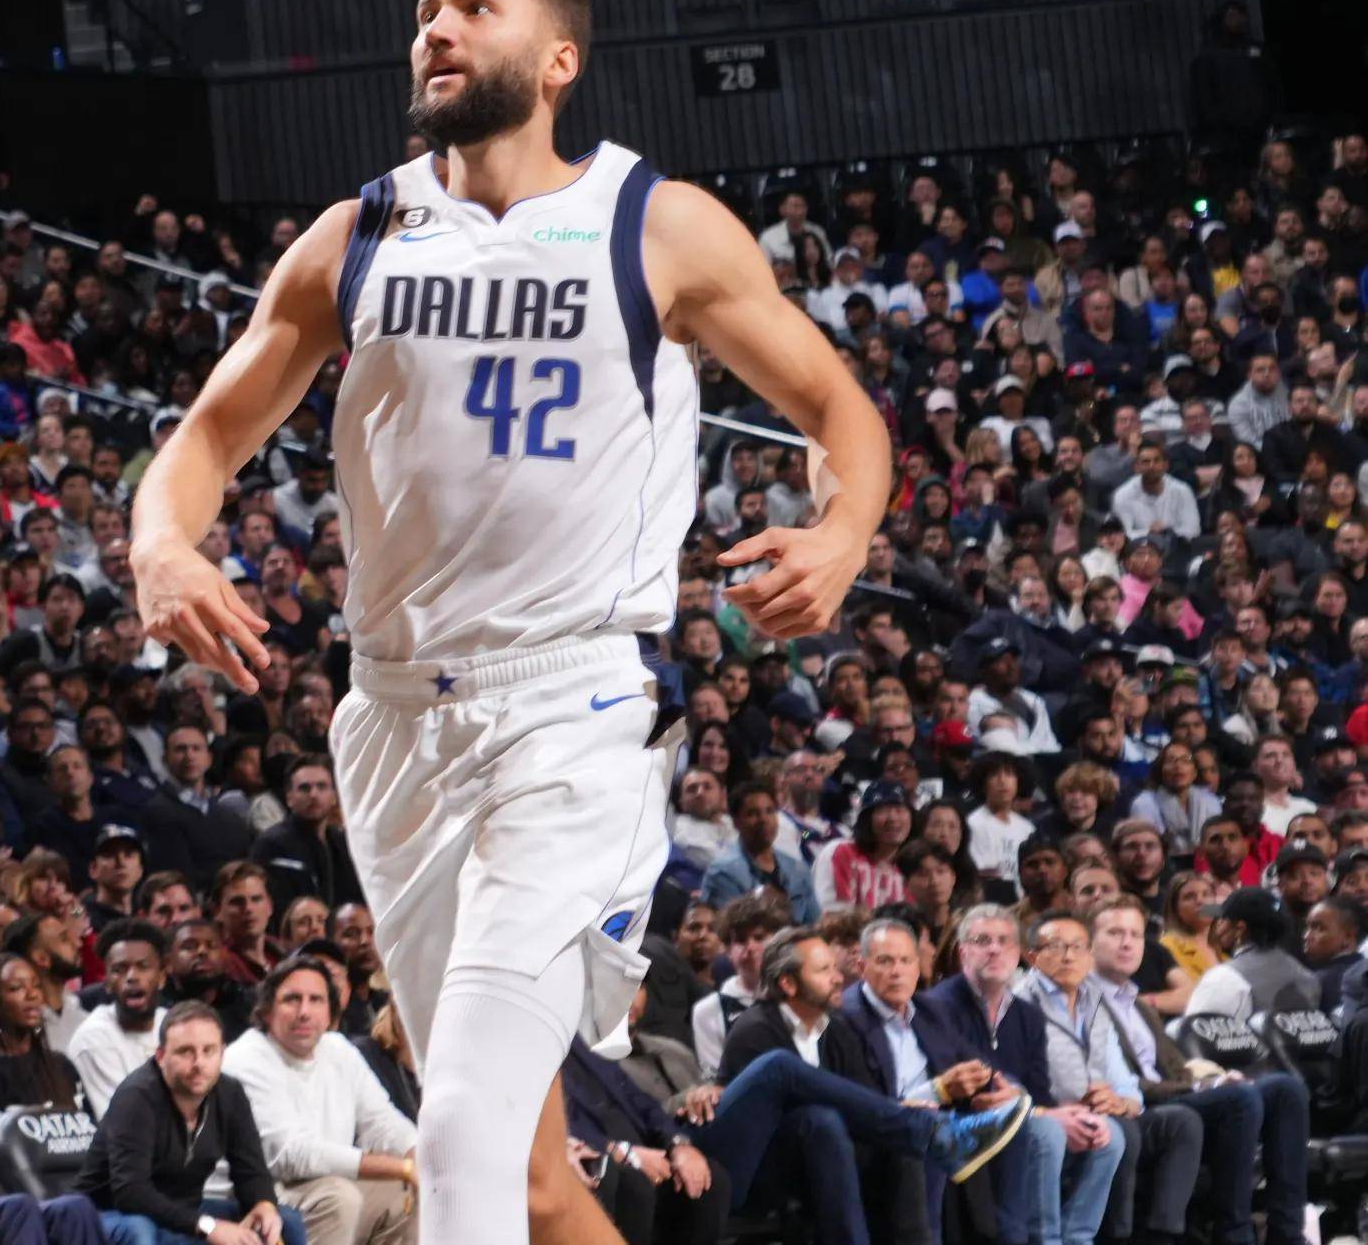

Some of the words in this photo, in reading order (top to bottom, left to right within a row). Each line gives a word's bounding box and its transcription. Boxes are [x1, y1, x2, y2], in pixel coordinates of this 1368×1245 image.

[719, 62, 756, 90] 28
[533, 226, 601, 242] chime
[380, 276, 590, 342] DALLAS
[463, 355, 581, 461] 42
[17, 1112, 97, 1144] QATAR
